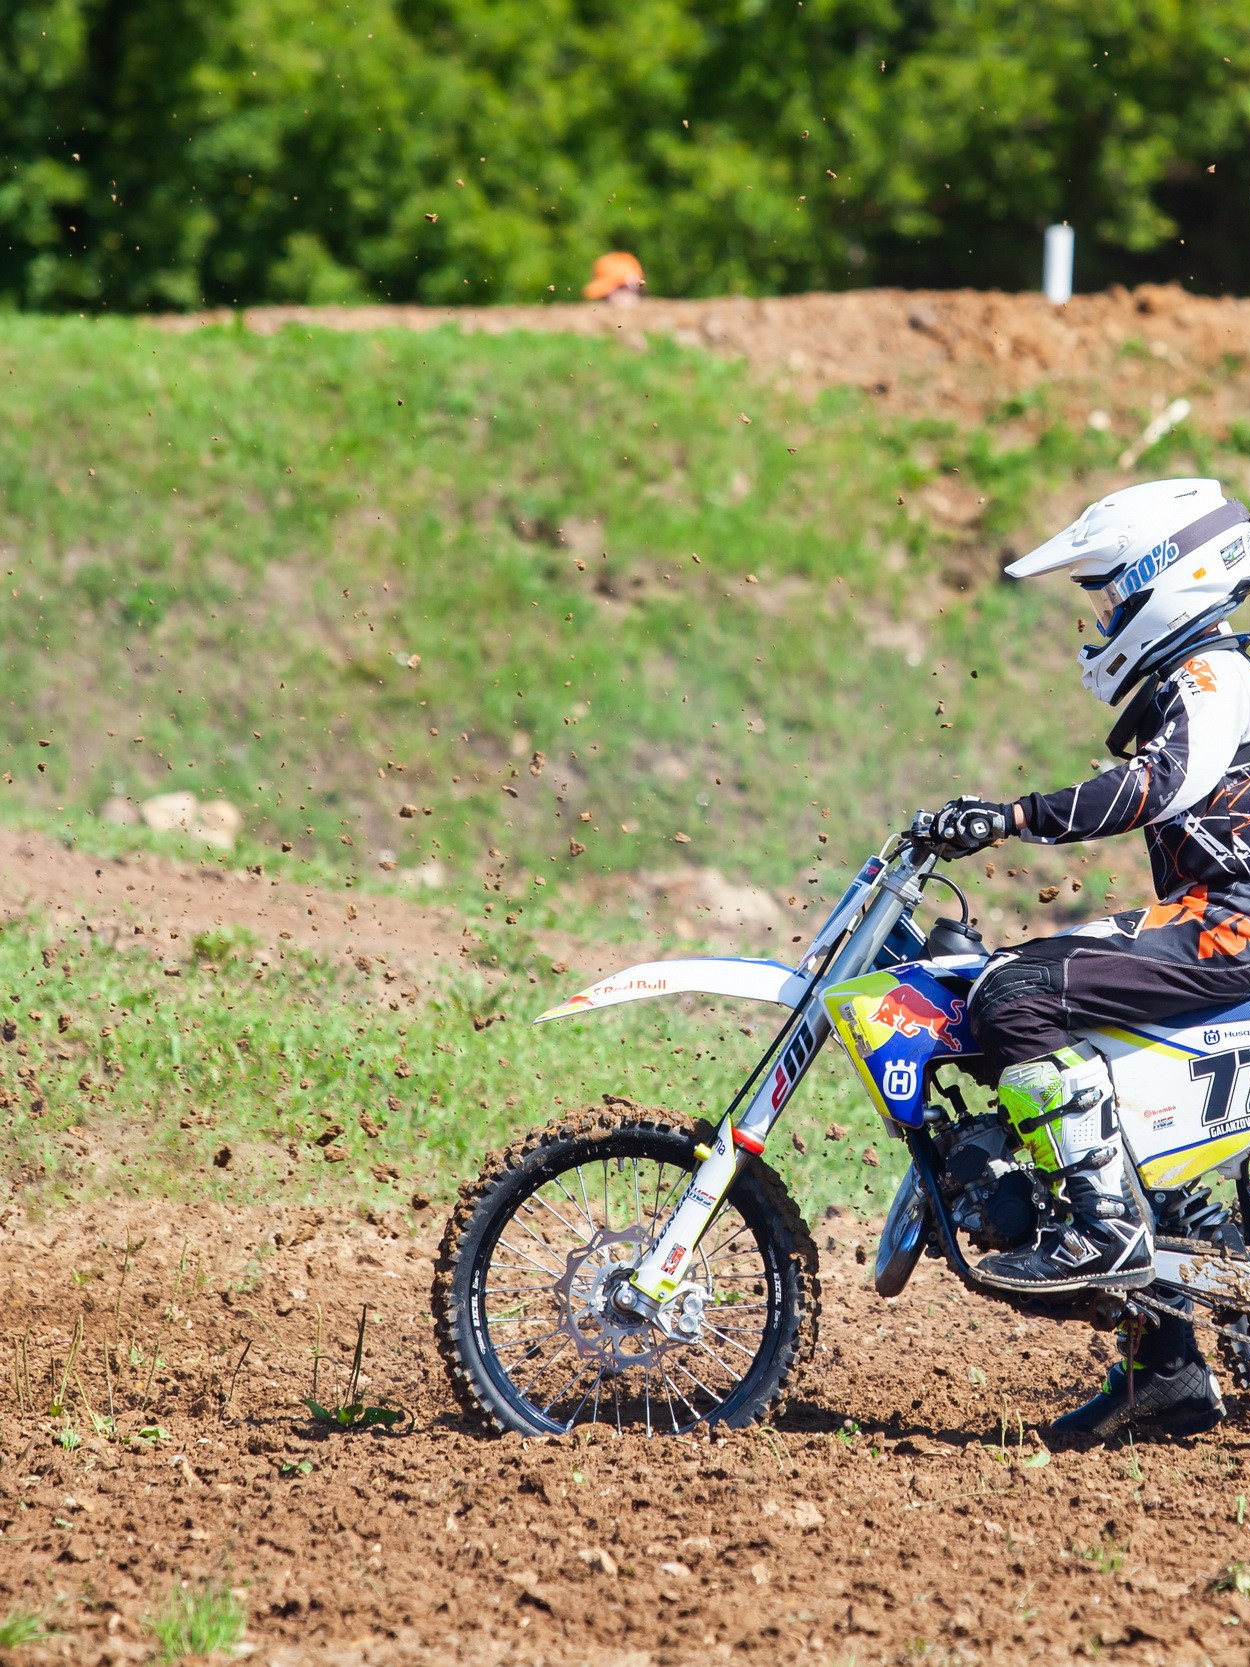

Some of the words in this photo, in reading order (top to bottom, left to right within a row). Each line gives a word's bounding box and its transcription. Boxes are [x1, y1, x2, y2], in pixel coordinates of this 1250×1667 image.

[1116, 538, 1180, 602] 100%
[637, 979, 666, 990] Bull
[773, 1273, 782, 1305] EXCEL
